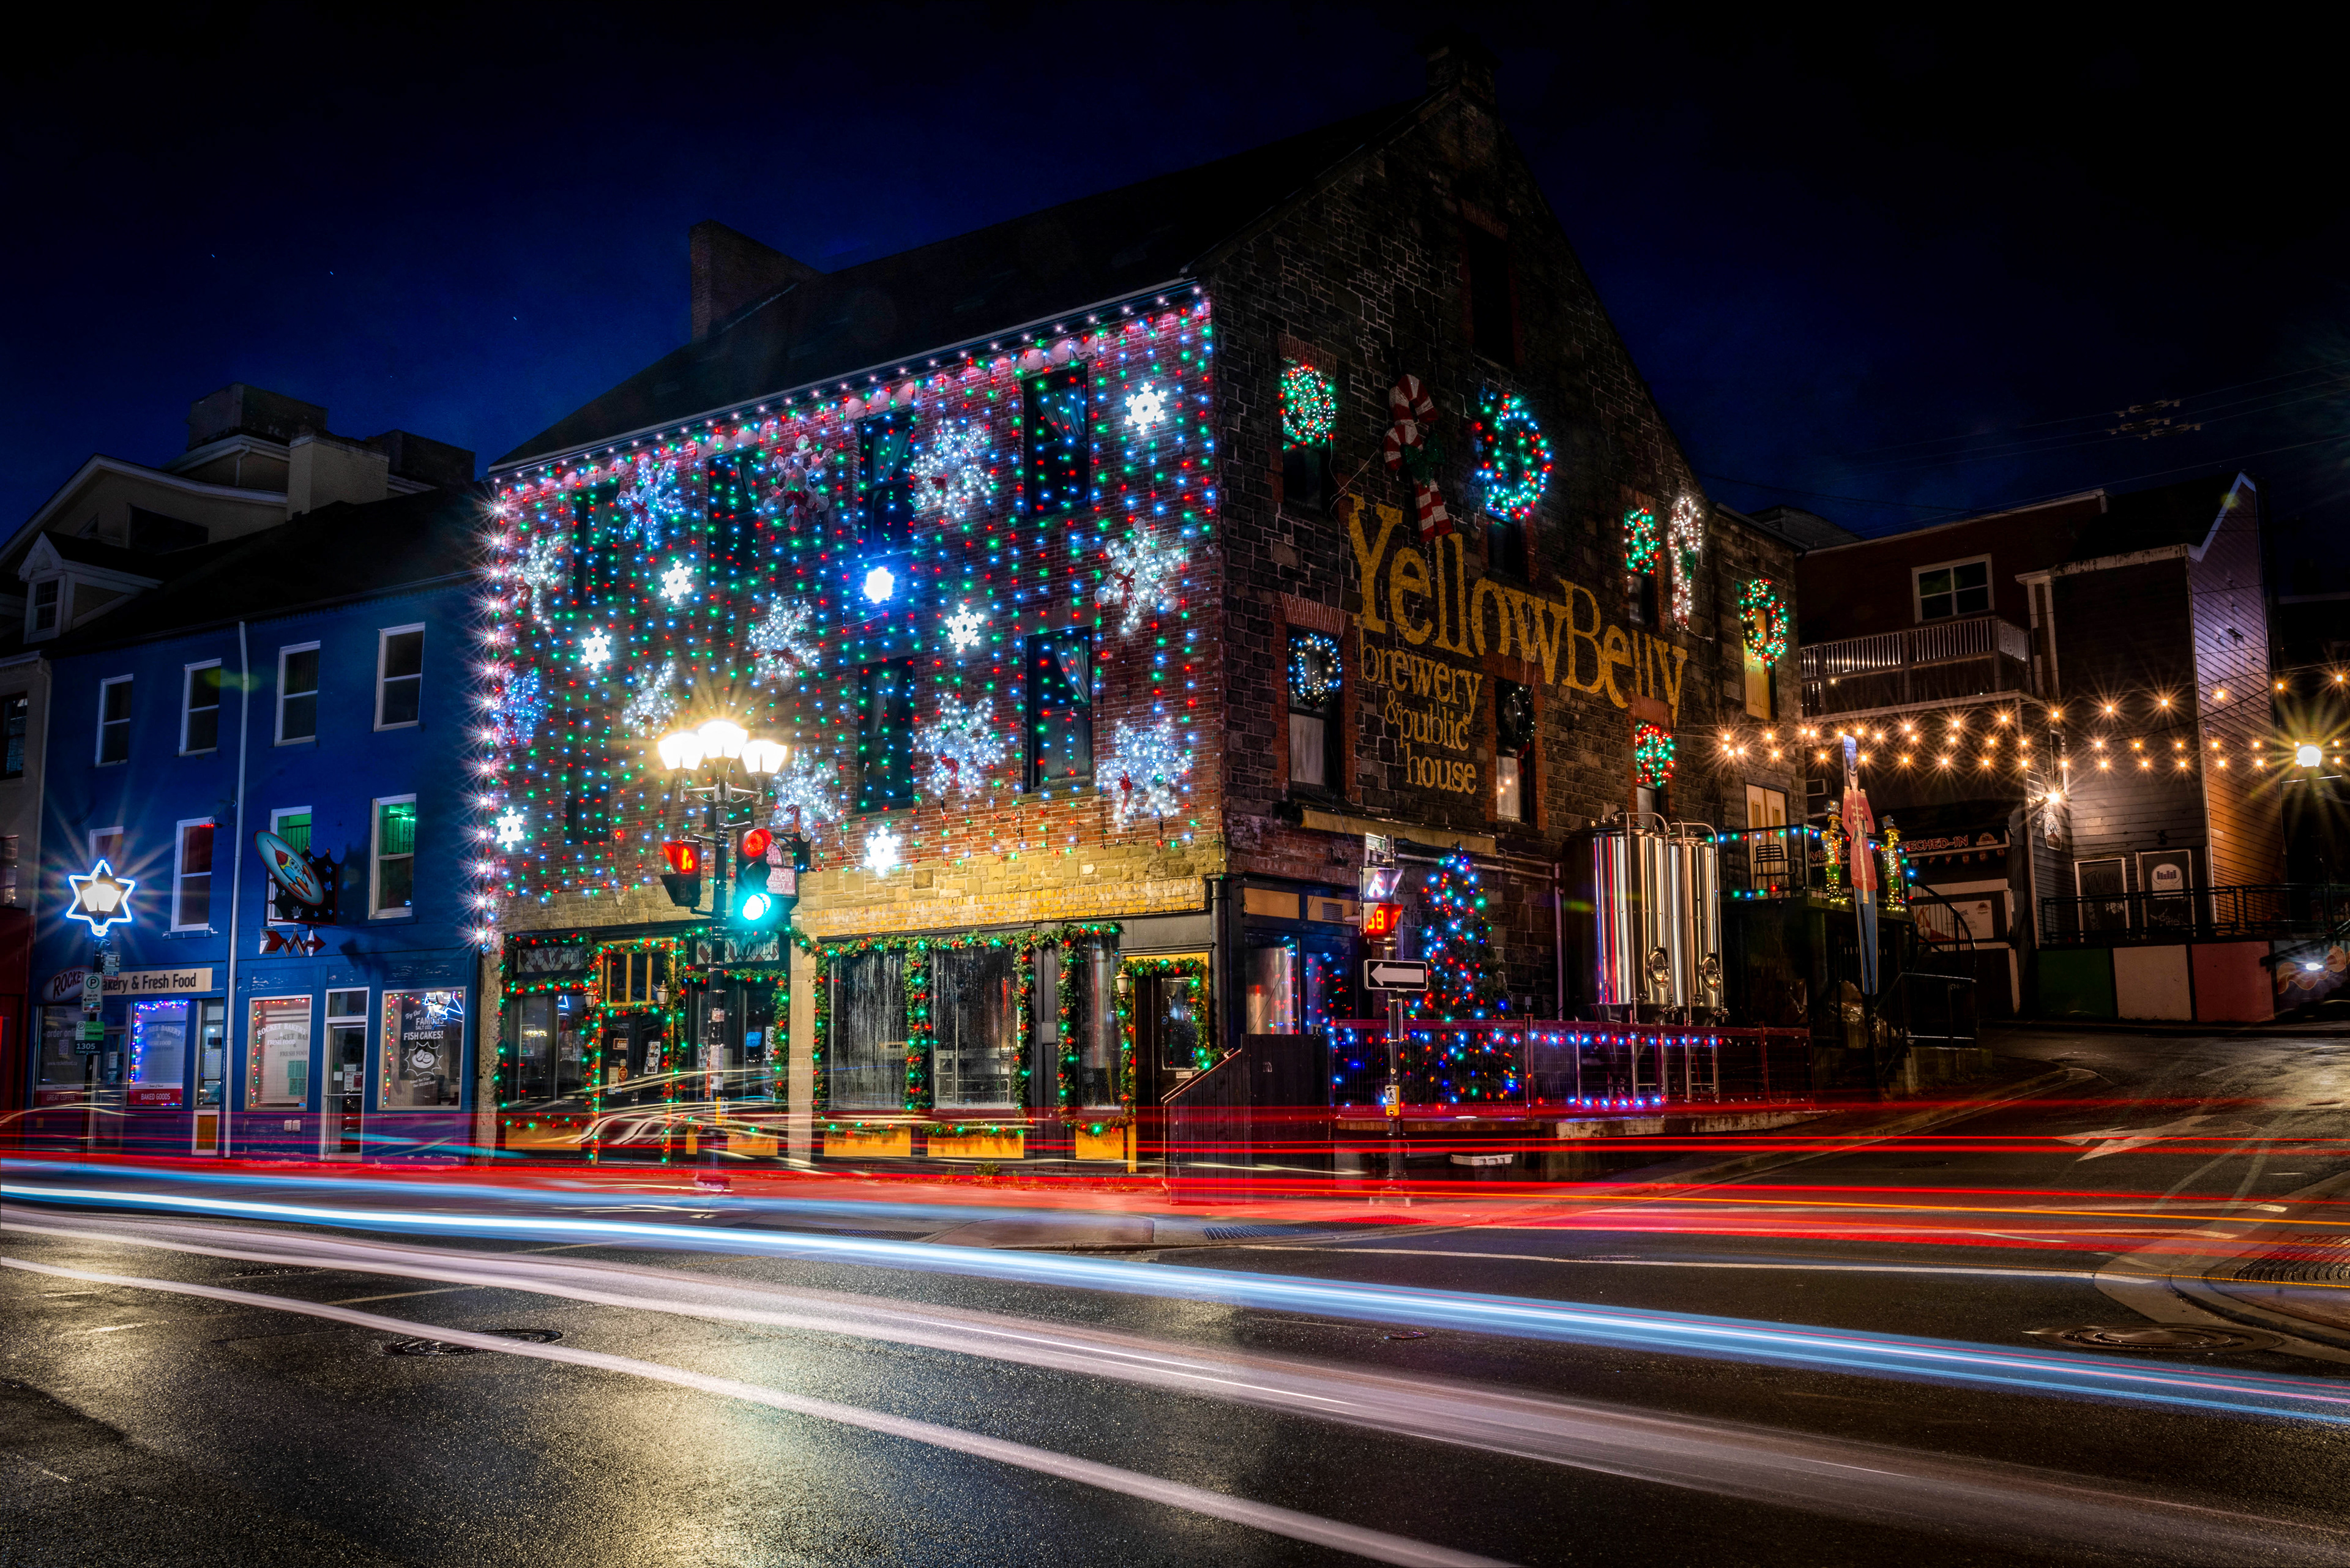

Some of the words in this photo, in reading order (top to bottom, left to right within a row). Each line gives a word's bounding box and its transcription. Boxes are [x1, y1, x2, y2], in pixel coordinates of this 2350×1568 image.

[1348, 493, 1687, 728] YellowBelly
[1359, 621, 1483, 725] brewery
[1406, 742, 1477, 794] house
[769, 868, 794, 886] wBelly
[766, 881, 785, 890] rewery
[53, 971, 85, 1000] ROCKET
[103, 979, 128, 994] akery
[131, 975, 139, 989] &
[143, 973, 169, 989] Fresh
[173, 973, 196, 988] Food
[416, 1017, 444, 1026] FAMOUS
[64, 1028, 76, 1037] onli
[160, 1025, 182, 1037] BAKERY
[257, 1023, 282, 1037] ROCKET
[283, 1023, 307, 1036] BAKERY
[404, 1031, 419, 1040] FISH
[420, 1030, 444, 1040] CAKES!
